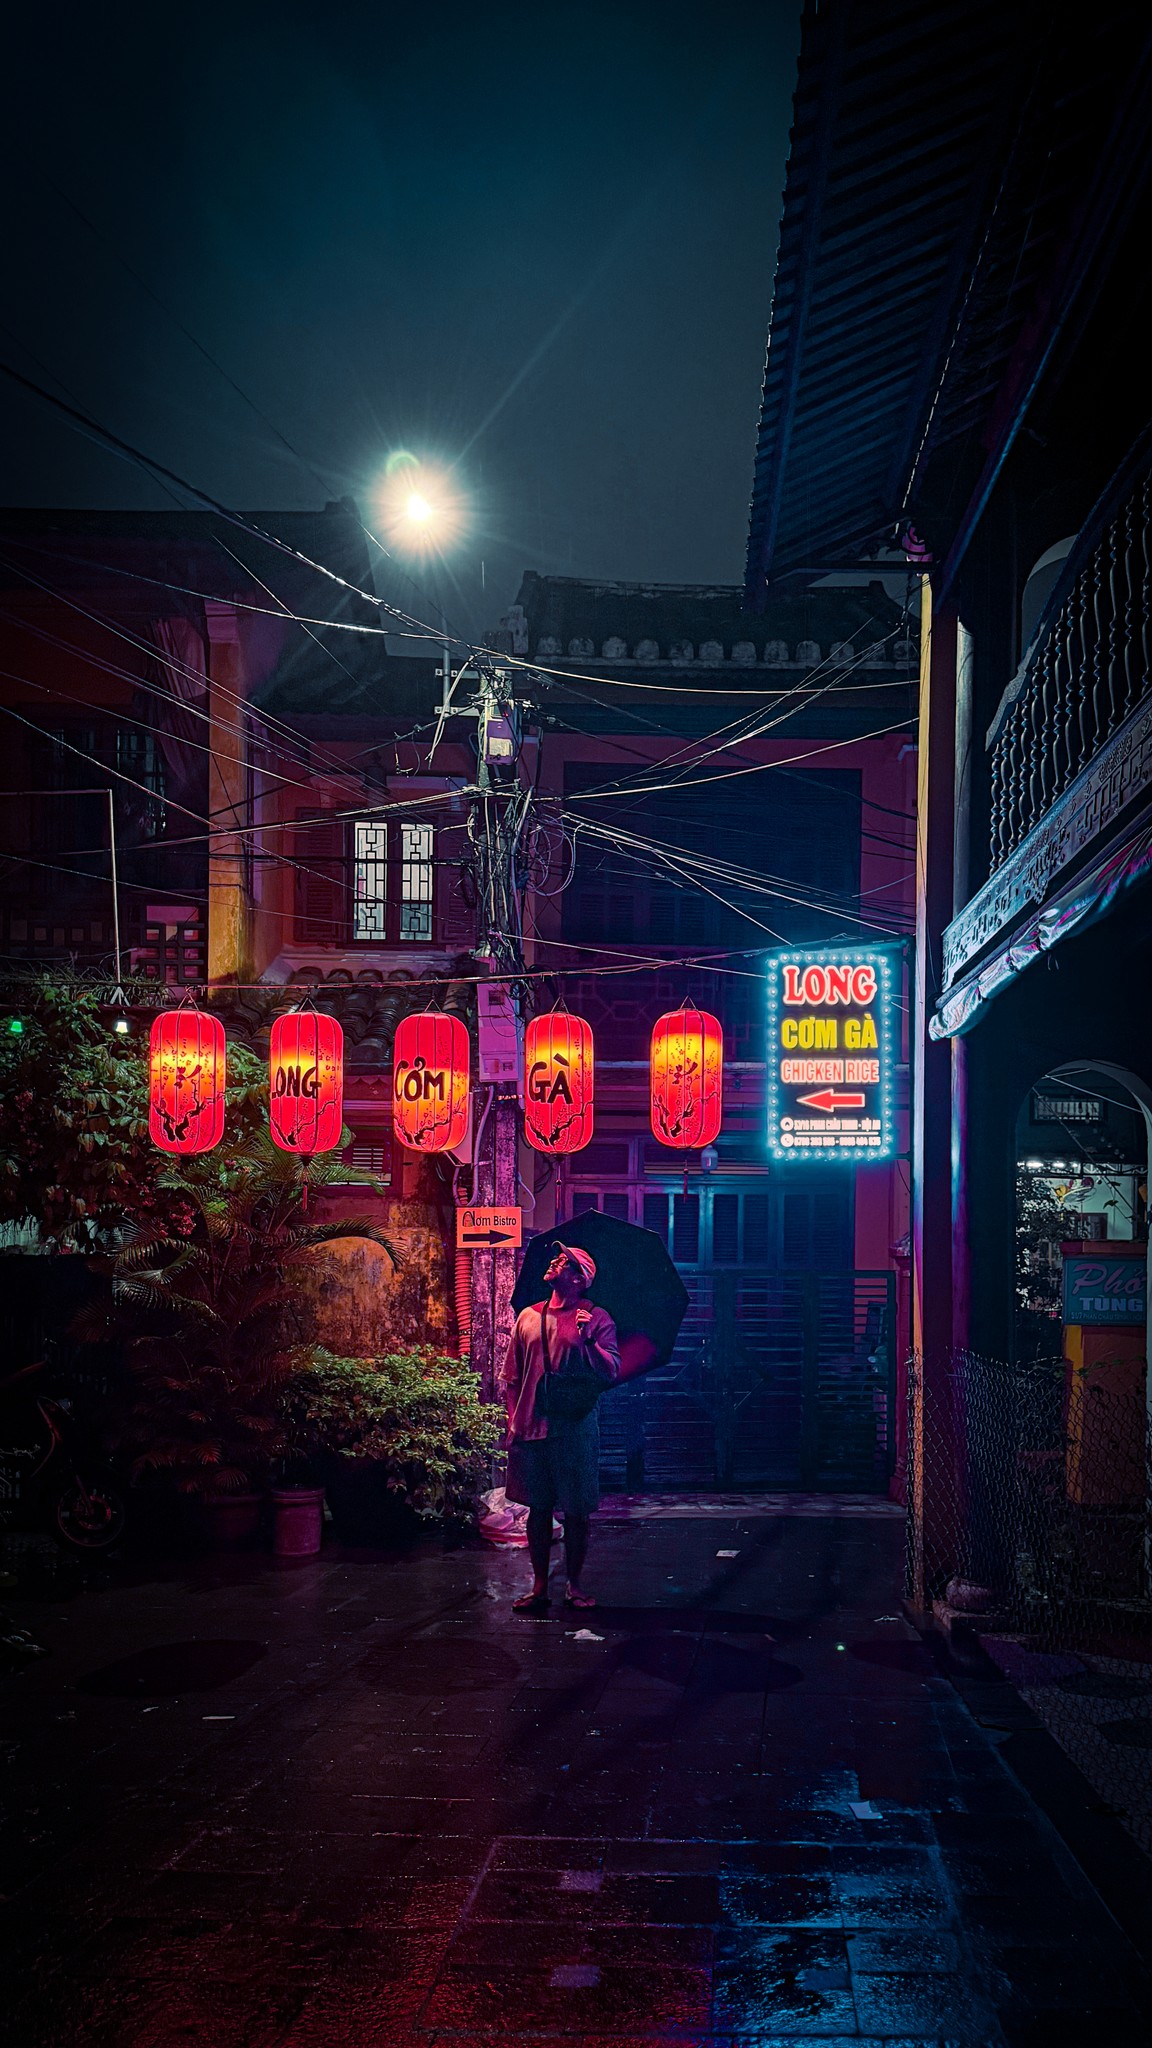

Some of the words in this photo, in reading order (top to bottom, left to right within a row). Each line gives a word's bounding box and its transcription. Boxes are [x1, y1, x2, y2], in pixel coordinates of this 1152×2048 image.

[782, 965, 877, 1005] LONG
[781, 1016, 838, 1049] CƠM
[844, 1013, 878, 1049] GÀ
[271, 1065, 322, 1099] ONG
[528, 1053, 573, 1104] GÀ
[781, 1059, 844, 1083] CHICKEN
[845, 1059, 880, 1083] RICE
[493, 1215, 517, 1226] Bistro
[1079, 1294, 1144, 1312] TÙNG
